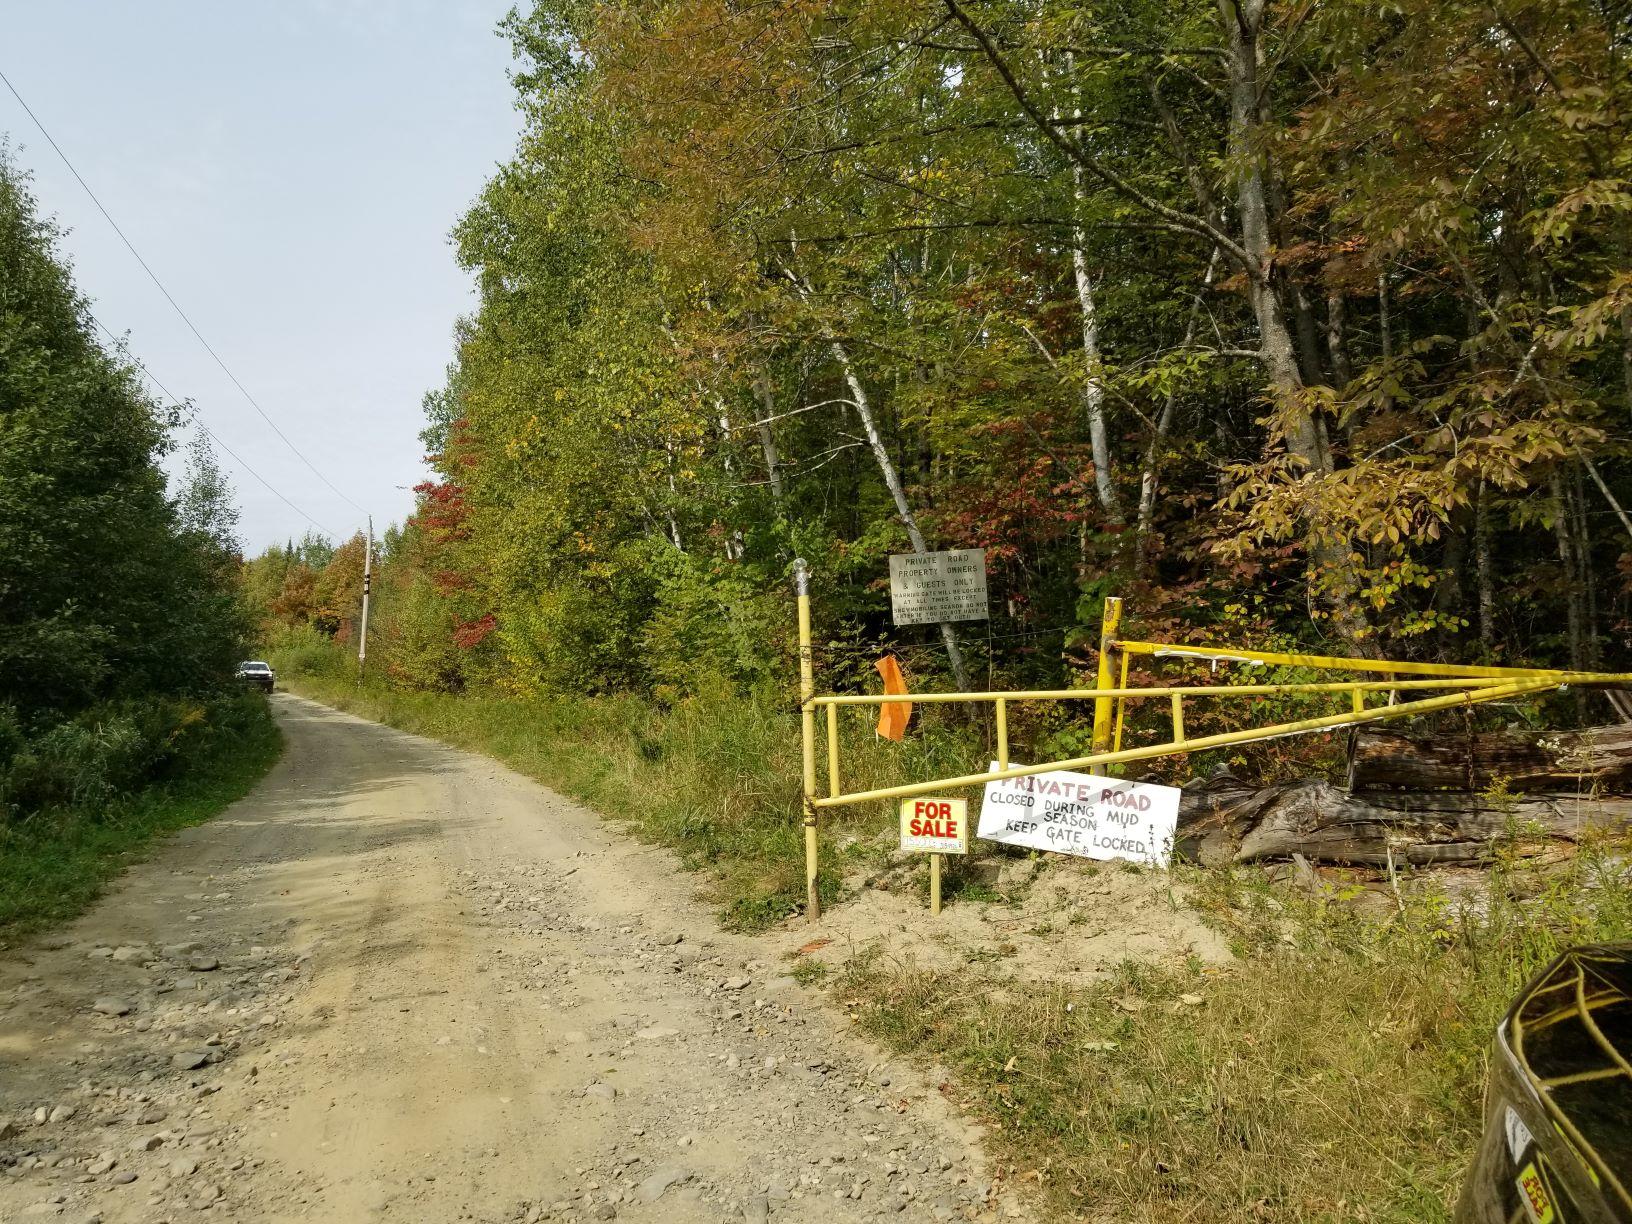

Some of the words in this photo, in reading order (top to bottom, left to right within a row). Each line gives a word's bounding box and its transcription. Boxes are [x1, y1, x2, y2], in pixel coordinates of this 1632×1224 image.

[906, 557, 936, 565] PRIVATE
[899, 569, 937, 578] PROPERTY
[1001, 776, 1090, 801] PRIVATE
[1100, 789, 1151, 811] ROAD
[914, 801, 952, 820] FOR
[991, 792, 1034, 807] CLOSED
[1045, 800, 1094, 817] DURING
[1107, 810, 1139, 826] MUD
[910, 818, 958, 838] SALE
[1044, 812, 1097, 830] SEASON
[1006, 819, 1038, 834] KEEP
[1047, 826, 1082, 843] GATE
[1093, 835, 1145, 854] LOCKED
